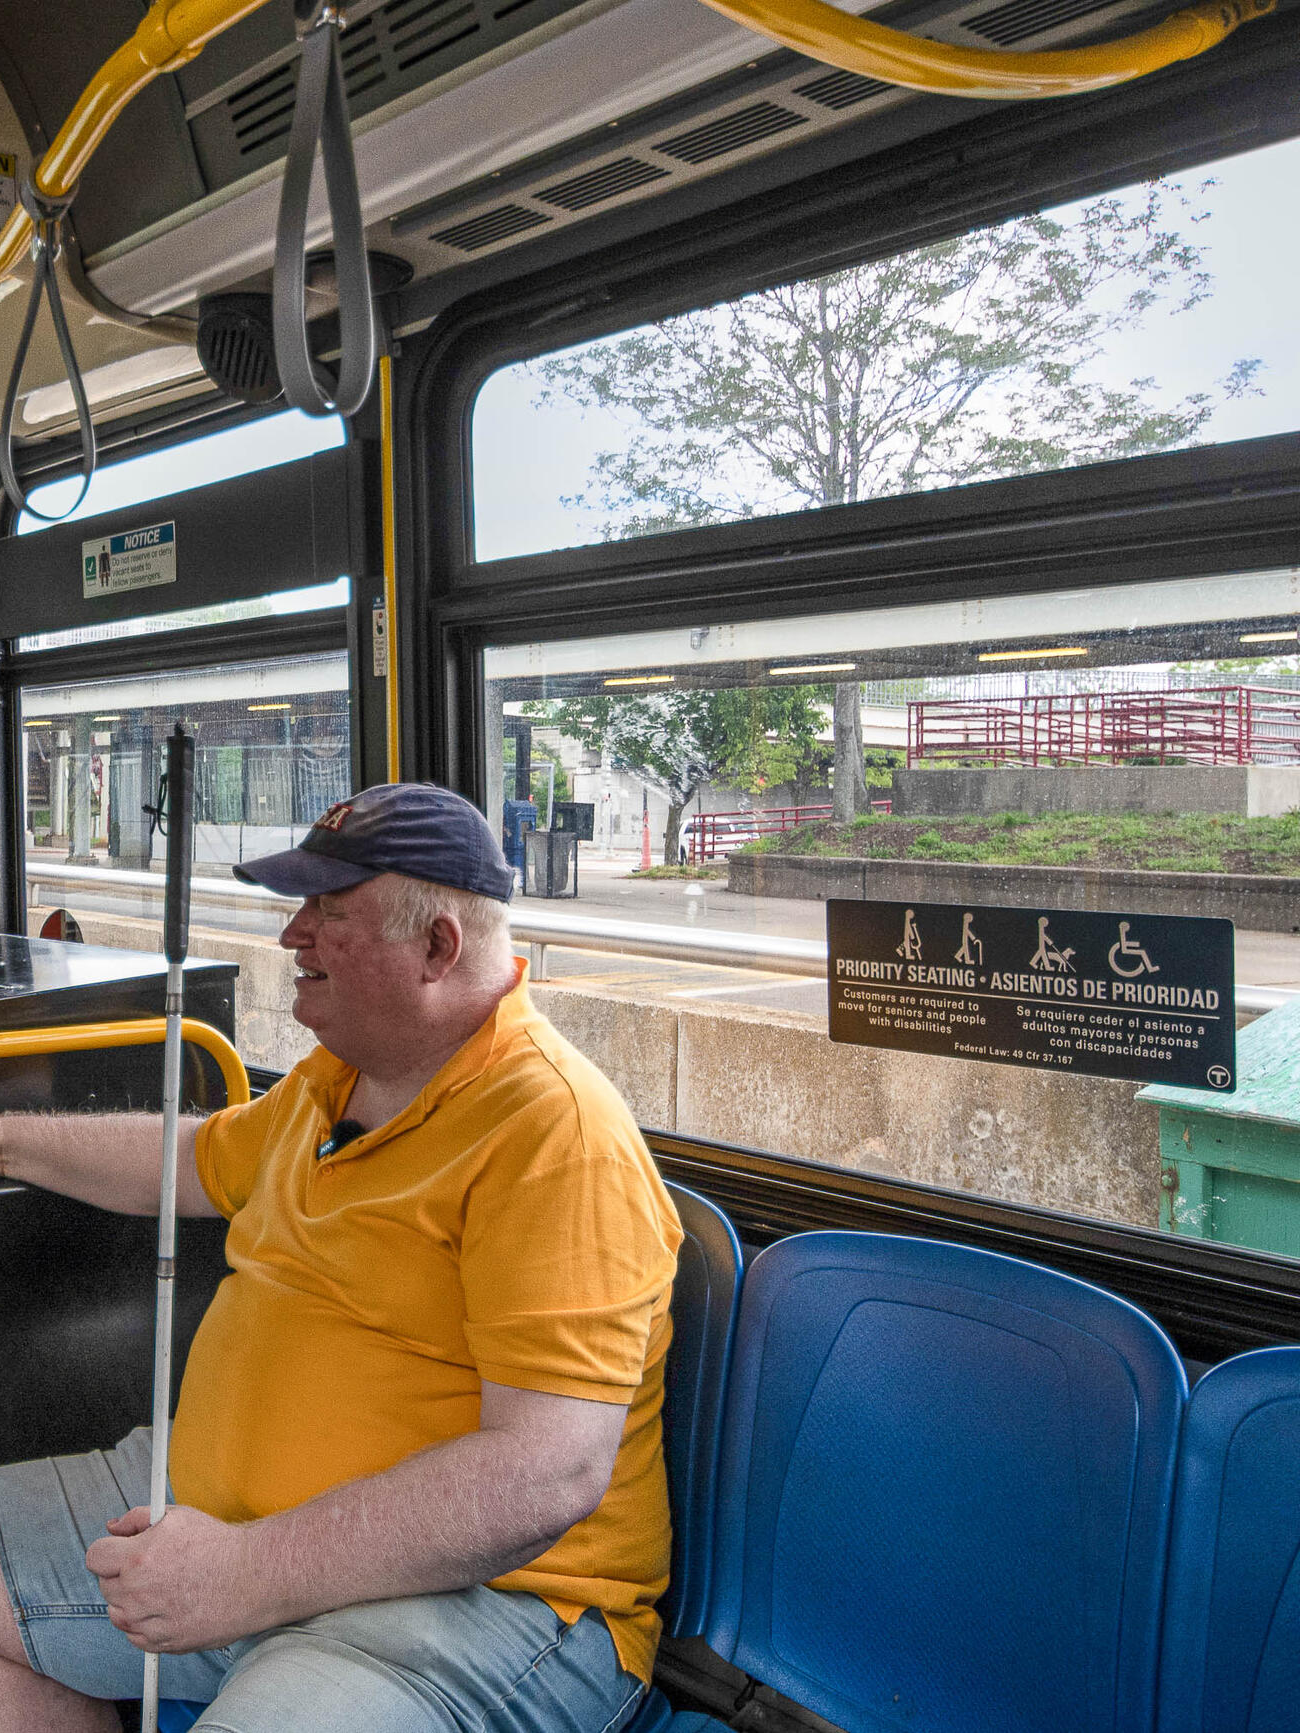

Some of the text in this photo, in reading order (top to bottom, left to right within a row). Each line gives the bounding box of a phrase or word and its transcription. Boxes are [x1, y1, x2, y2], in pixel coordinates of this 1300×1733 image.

[124, 528, 160, 550] NOTICE
[120, 556, 130, 565] not
[130, 552, 150, 562] reserve
[152, 550, 158, 558] or
[836, 958, 1220, 1011] PRIORITY SEATING ASIENTOS DE PRIORIDAD
[843, 988, 979, 1012] Customers are required to
[838, 1001, 986, 1025] move for seniors and people
[1016, 1006, 1205, 1036] Se requiere ceder el asiento a
[869, 1016, 952, 1034] with disabilities
[1022, 1021, 1199, 1050] adultos mayores y personas
[954, 1042, 1073, 1065] Federal Law: 49 Cfr 37.167
[1050, 1038, 1172, 1061] con discapacidades
